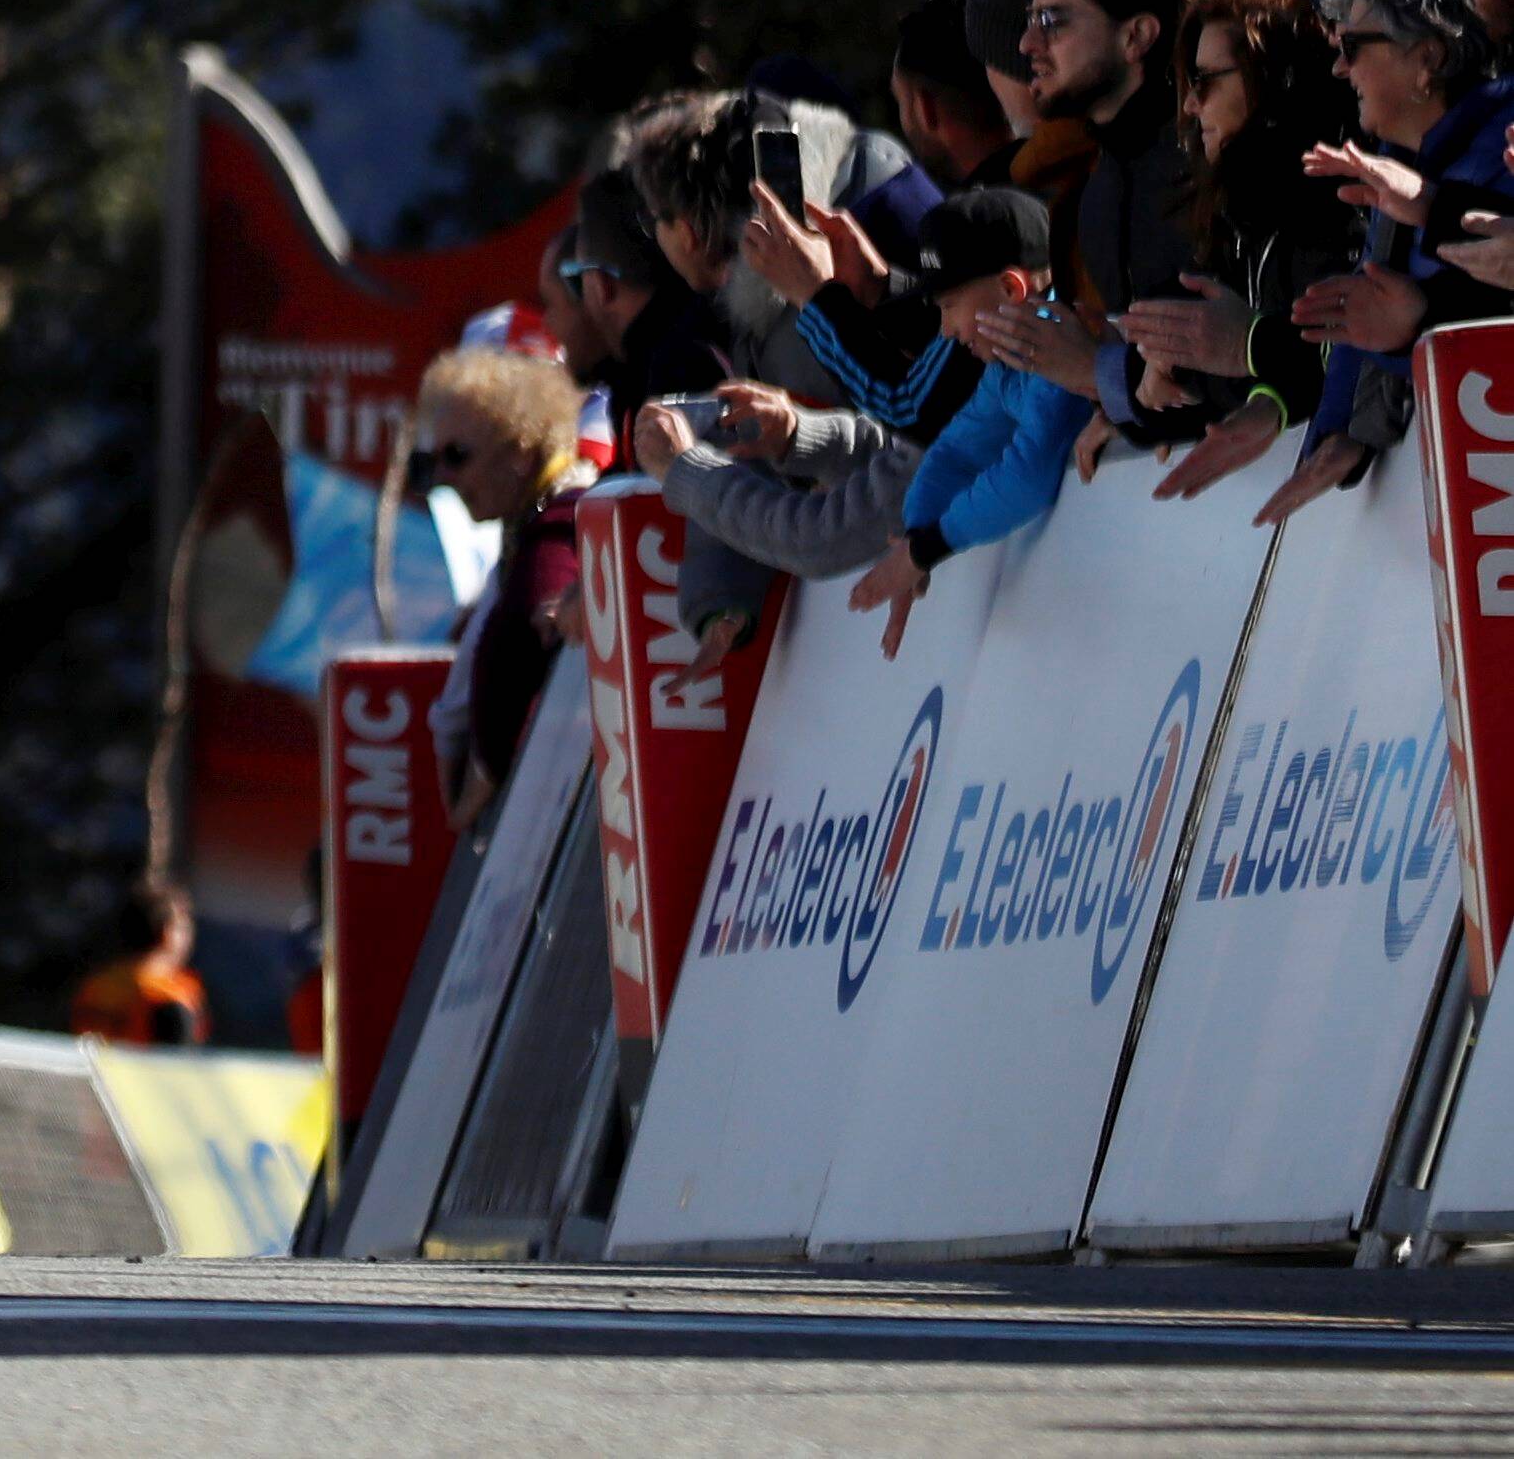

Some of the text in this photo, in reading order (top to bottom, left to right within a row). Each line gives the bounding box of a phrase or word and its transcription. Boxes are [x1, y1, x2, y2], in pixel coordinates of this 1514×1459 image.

[342, 685, 414, 866] RMC
[582, 532, 644, 986] RMC
[1196, 708, 1415, 902] E.Leclerc
[699, 788, 873, 958] E.Leclerc
[918, 772, 1119, 953] E.Leclerc
